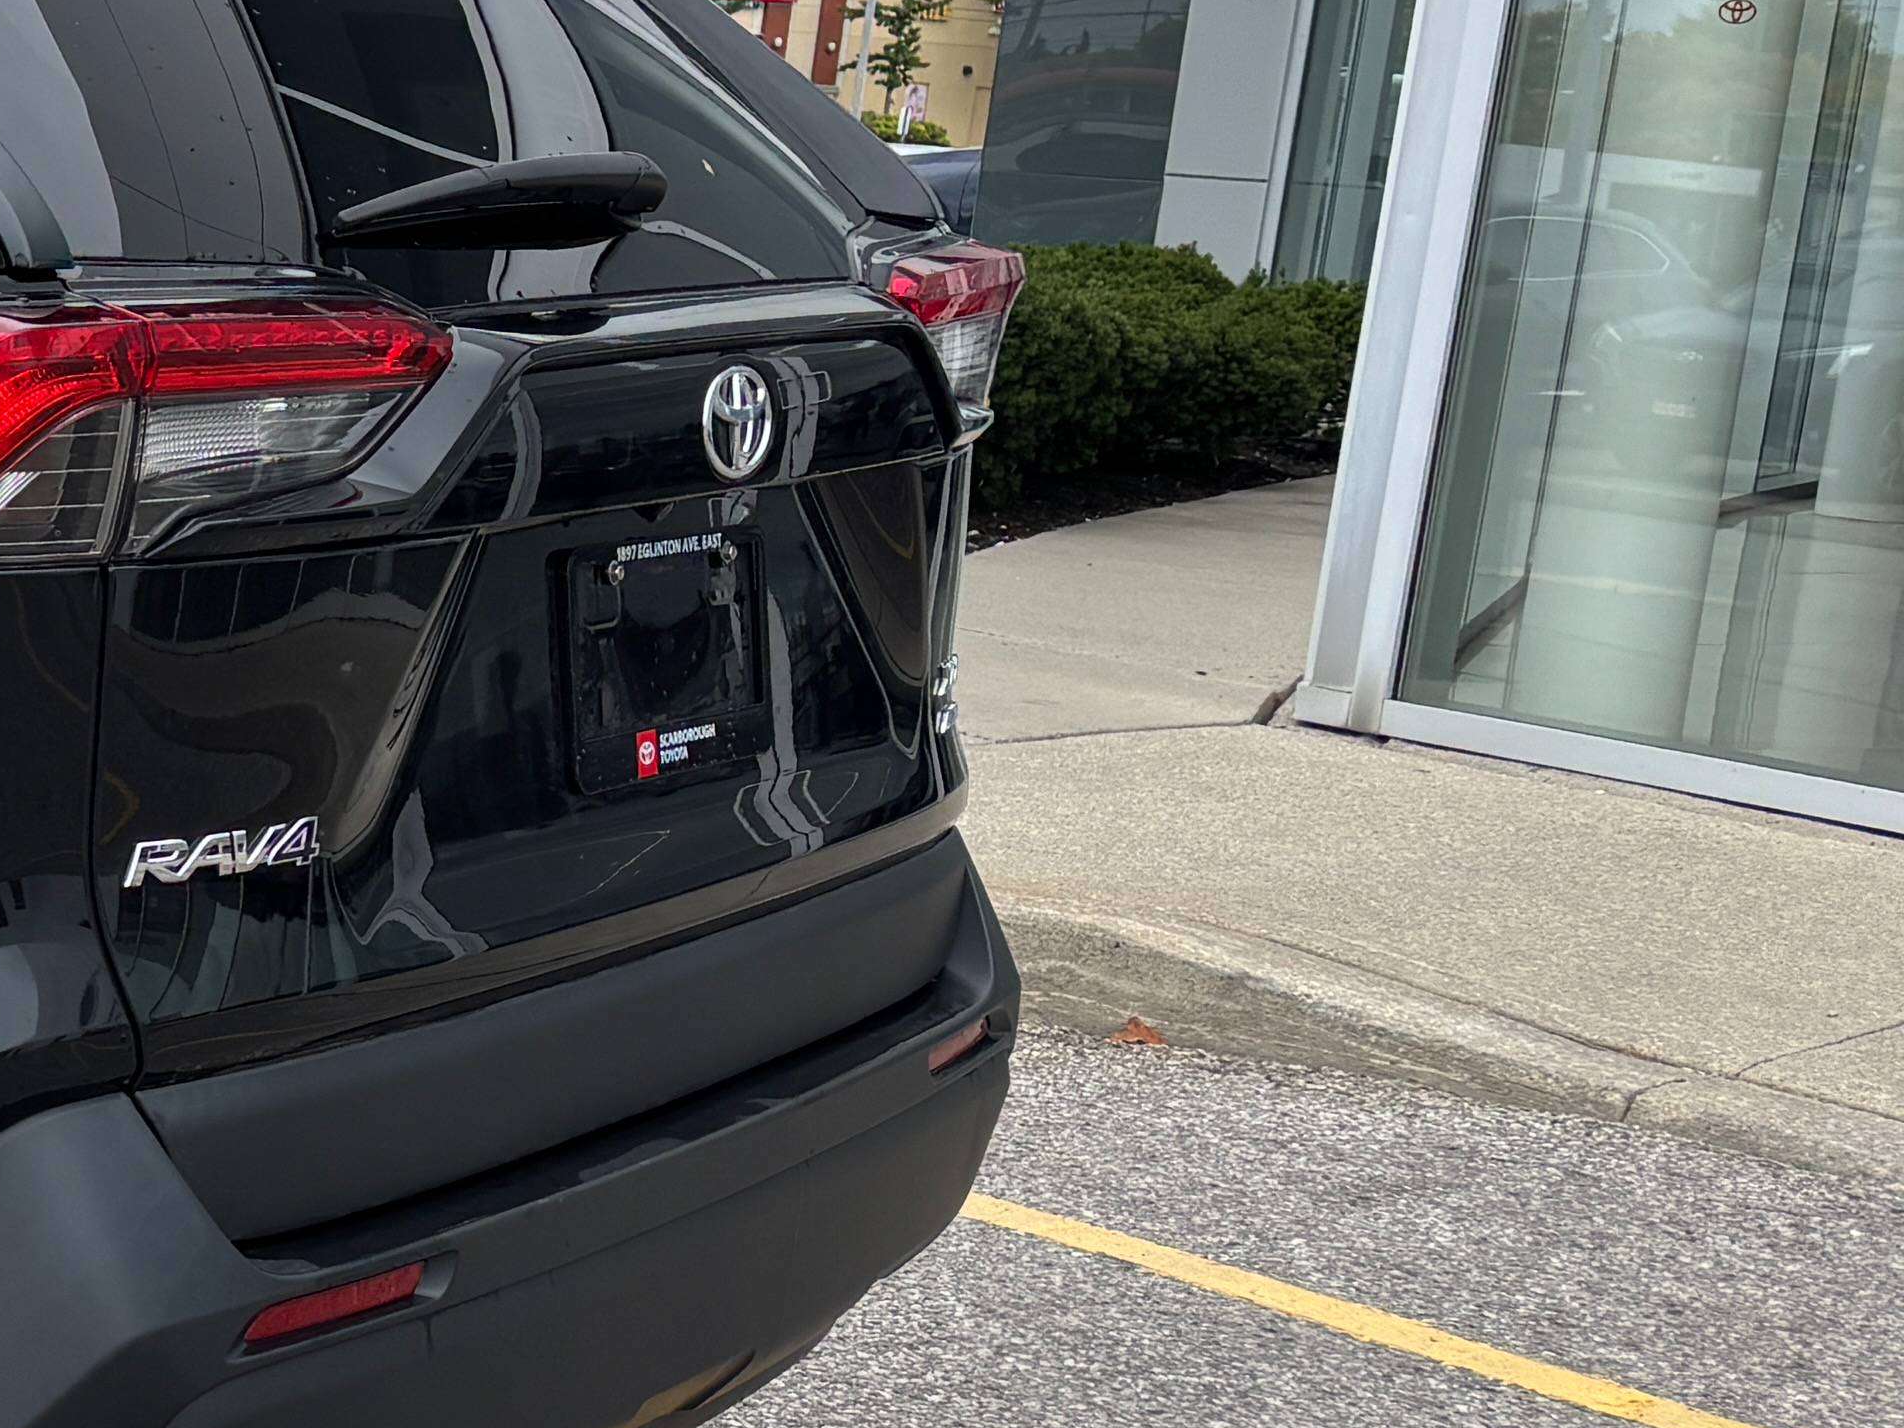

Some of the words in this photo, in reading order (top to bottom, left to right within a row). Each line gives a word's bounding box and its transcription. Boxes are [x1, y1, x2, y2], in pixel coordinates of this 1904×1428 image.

[616, 544, 636, 562] 1897
[637, 538, 682, 559] EGLINTON
[702, 532, 722, 550] EAST
[659, 723, 716, 748] SCARBOROUGH
[659, 745, 689, 764] TOYOTA
[123, 815, 320, 889] RAV4
